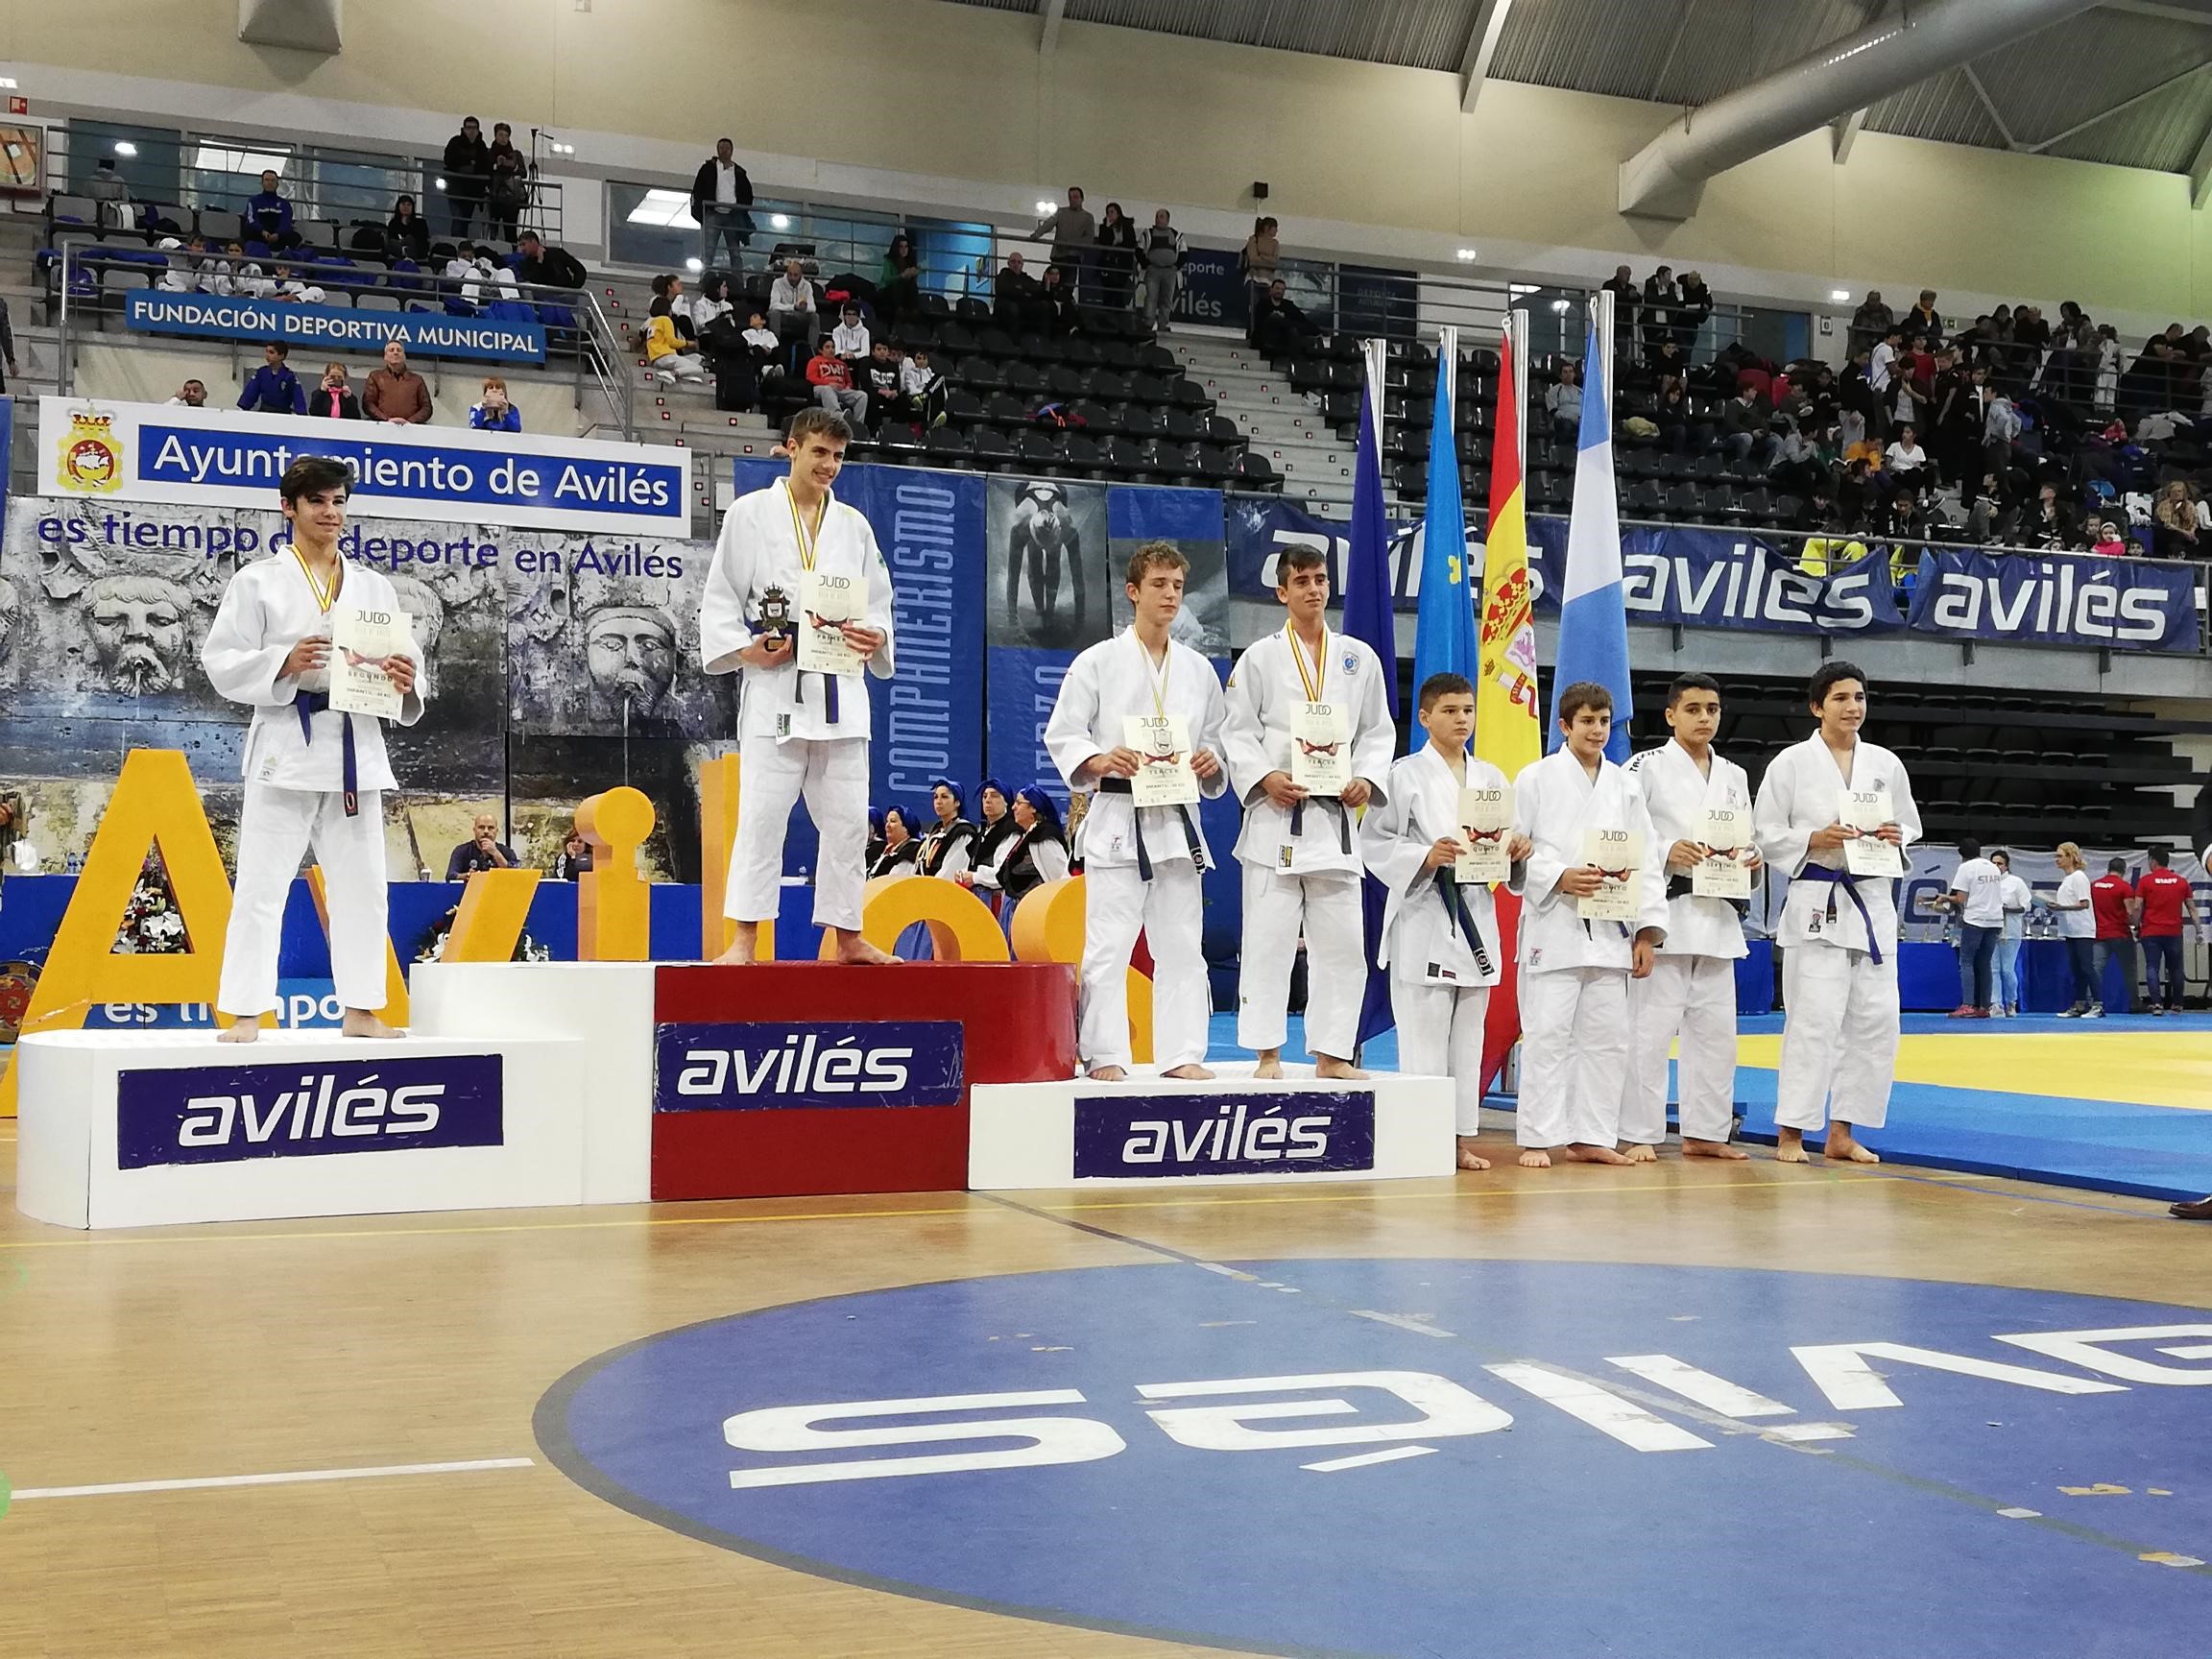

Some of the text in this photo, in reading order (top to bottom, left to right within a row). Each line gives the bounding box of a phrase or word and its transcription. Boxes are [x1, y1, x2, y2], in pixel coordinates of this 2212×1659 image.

[1171, 289, 1222, 318] vilés
[134, 301, 539, 353] FUNDACIÓN DEPORTIVA MUNICIPAL
[489, 457, 541, 497] de
[554, 465, 669, 507] Avilés
[37, 516, 86, 543] es
[103, 511, 259, 560] tiempo
[338, 524, 499, 570] deporte
[515, 549, 562, 574] en
[574, 540, 684, 579] Avilés
[818, 574, 851, 589] JUDO
[1934, 563, 2169, 641] avilés
[355, 610, 391, 625] JUDO
[1305, 704, 1332, 715] JUDO
[1475, 790, 1502, 802] JUDO
[1852, 792, 1878, 804] JUDO
[1708, 809, 1735, 822] JUDO
[1599, 830, 1628, 842] JUDO
[677, 1034, 913, 1095] avilés
[178, 1073, 445, 1148] avilés
[1121, 1104, 1332, 1164] avilés
